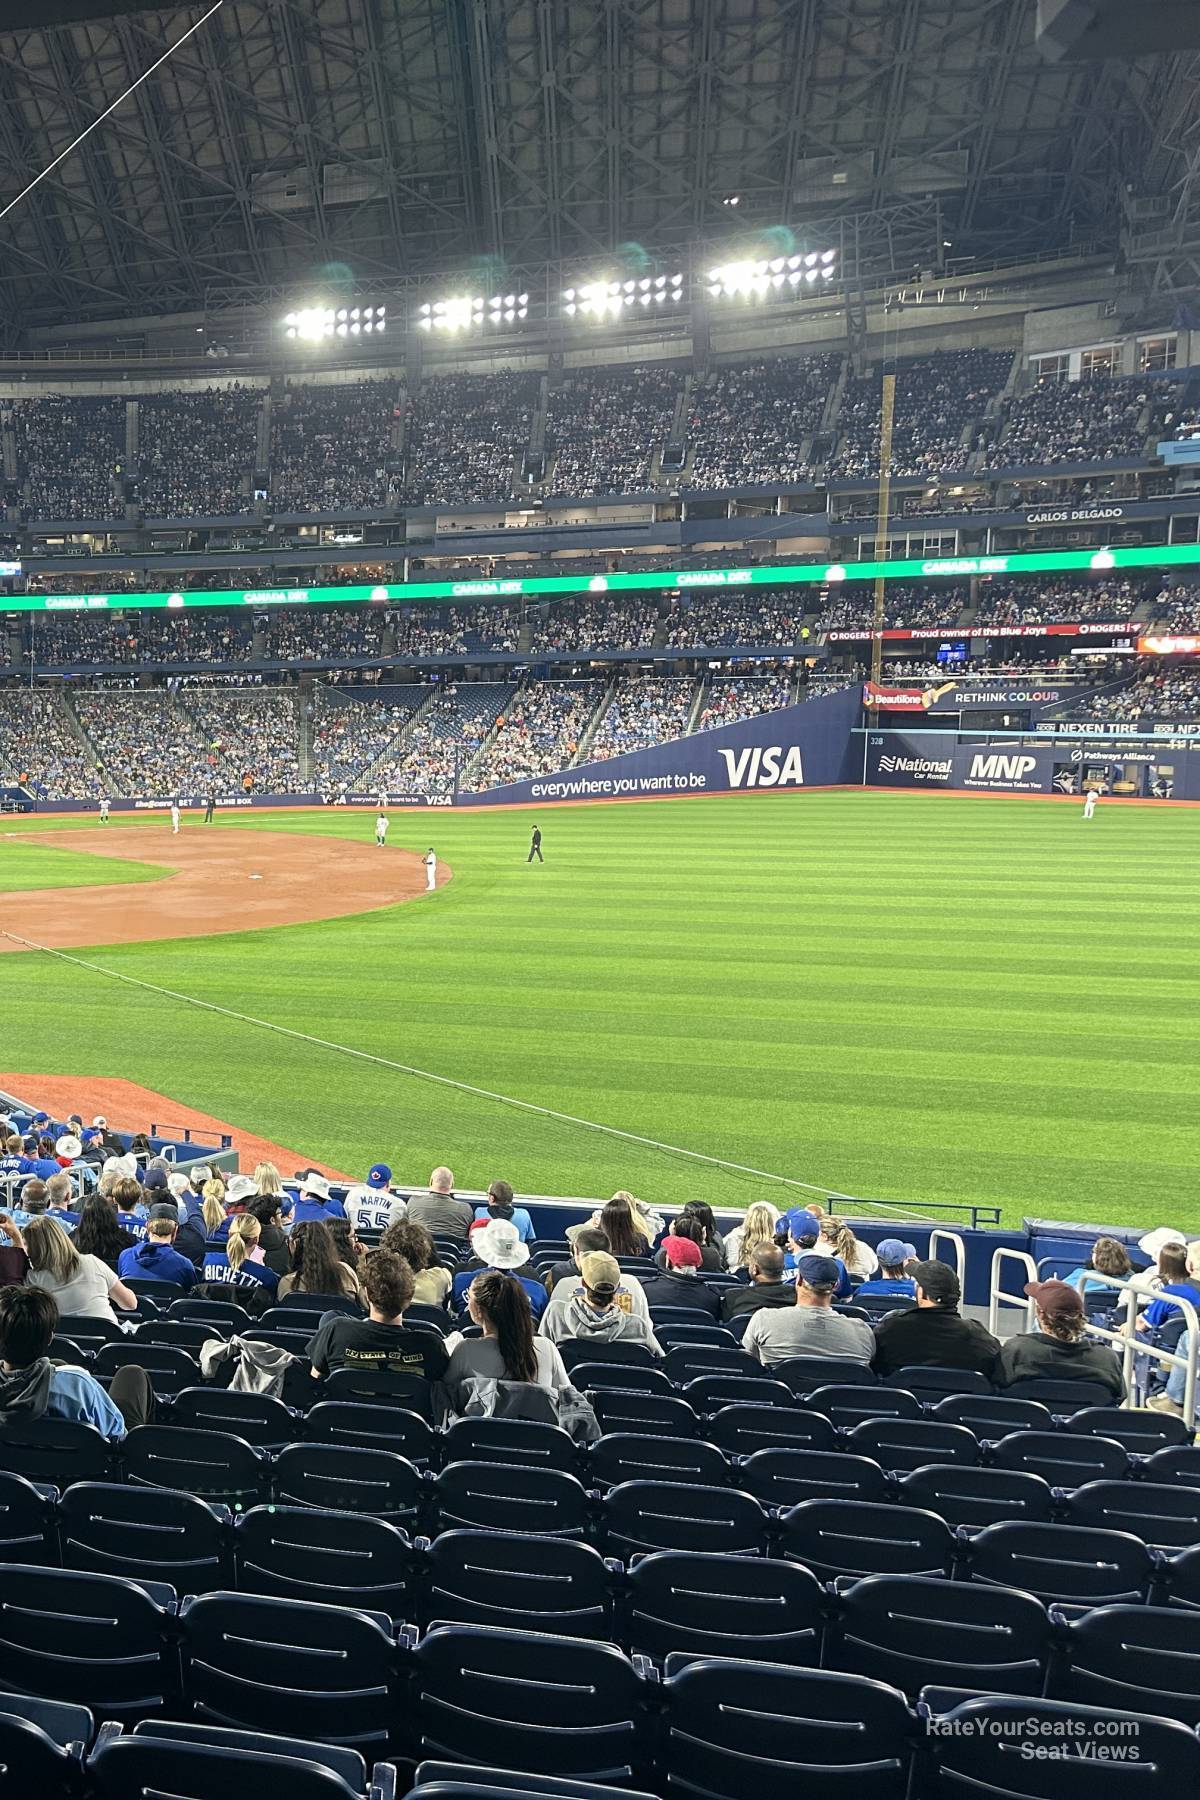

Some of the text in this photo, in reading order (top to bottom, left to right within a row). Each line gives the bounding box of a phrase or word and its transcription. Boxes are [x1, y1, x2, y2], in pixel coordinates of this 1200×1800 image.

[1027, 508, 1123, 522] CARLOS DELGADO
[922, 561, 976, 575] CANADA
[676, 573, 725, 586] CANADA
[453, 583, 498, 596] CANADA
[45, 597, 85, 609] CANADA
[243, 592, 286, 605] CANADA
[839, 624, 1125, 640] ROGERS Proud owner of the Blue Jays ROGERS
[875, 694, 921, 704] BeautiTone
[955, 691, 1059, 703] RETHINK COLOUR
[1060, 723, 1103, 733] NEXEN
[1107, 723, 1138, 733] TIRE
[1084, 752, 1155, 761] Pathways Alliance
[717, 746, 804, 788] VISA
[970, 754, 1036, 779] MNP
[927, 773, 949, 781] Rental
[532, 772, 706, 797] everywhere you want to be
[179, 799, 193, 807] BET
[237, 797, 253, 806] BOX
[425, 795, 452, 805] VISA
[0, 1158, 22, 1169] TRAVIS
[360, 1195, 393, 1210] MARTIN
[357, 1209, 391, 1229] 55
